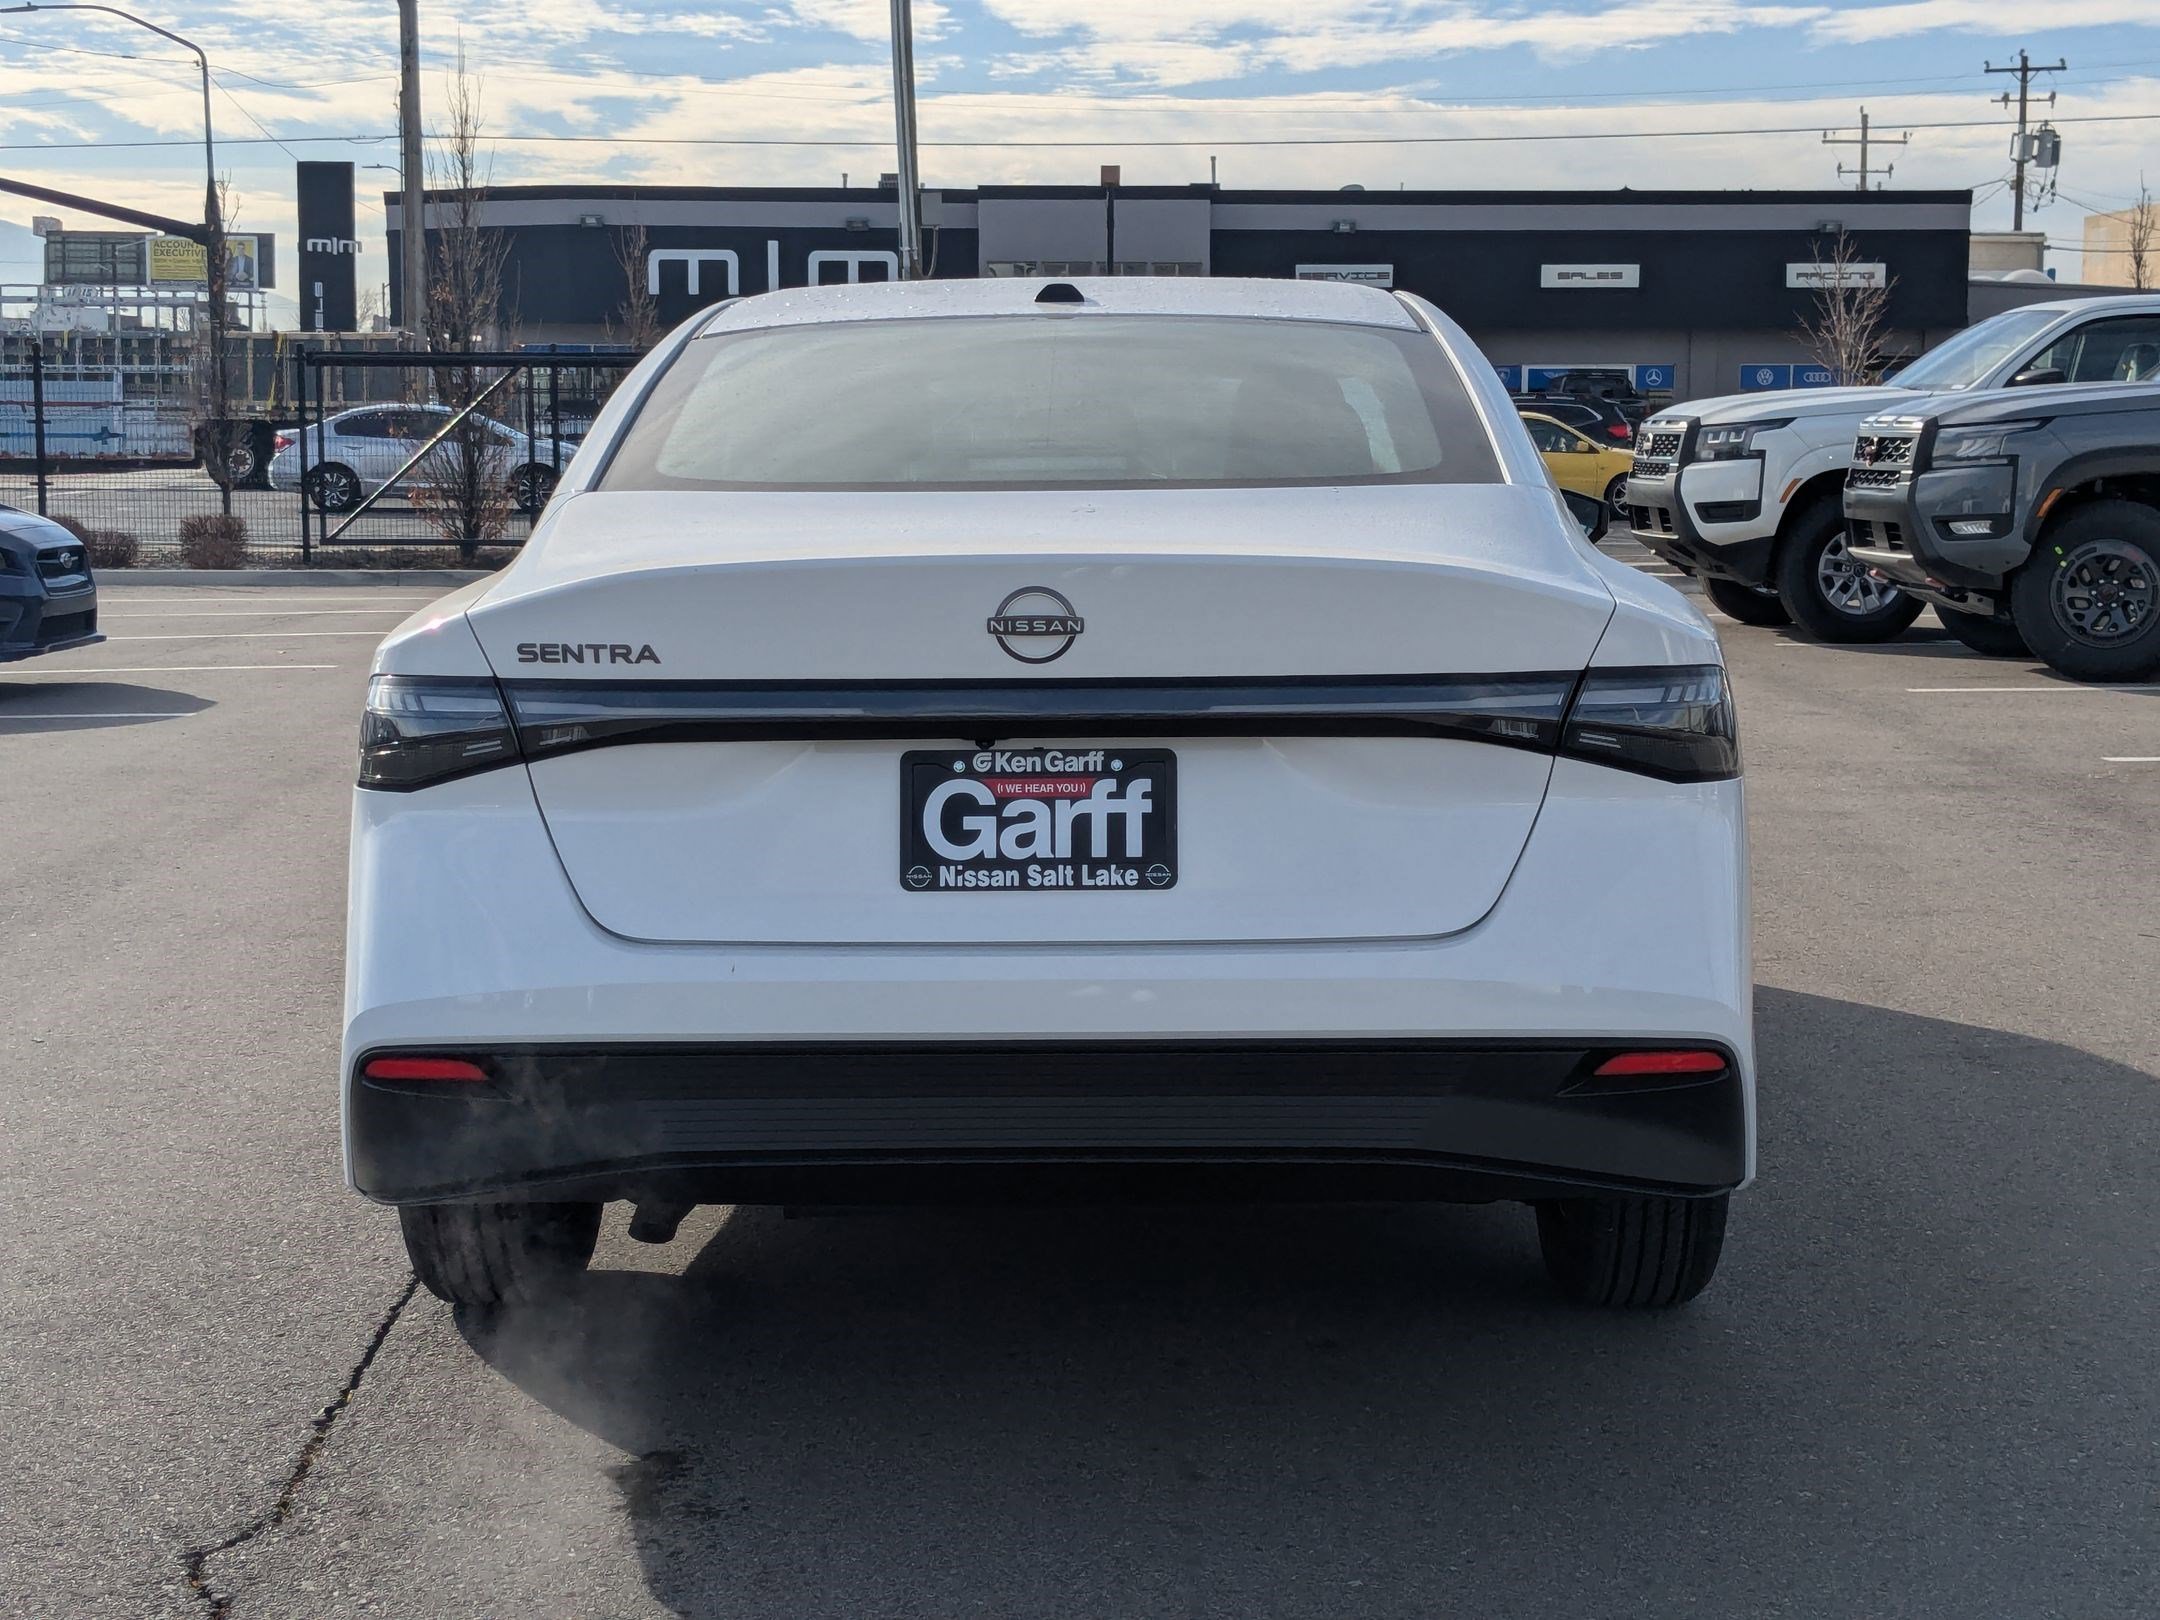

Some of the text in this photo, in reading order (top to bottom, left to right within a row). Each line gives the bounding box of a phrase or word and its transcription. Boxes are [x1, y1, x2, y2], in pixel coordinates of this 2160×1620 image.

[153, 240, 199, 249] ACCOUN
[990, 620, 1081, 632] NISSAN
[516, 643, 662, 664] SENTRA
[995, 751, 1105, 773] Ken Garff
[1005, 783, 1078, 793] WE HEAR YOU
[923, 778, 1152, 861] Garff
[939, 864, 1139, 887] Nissan Salt Lake
